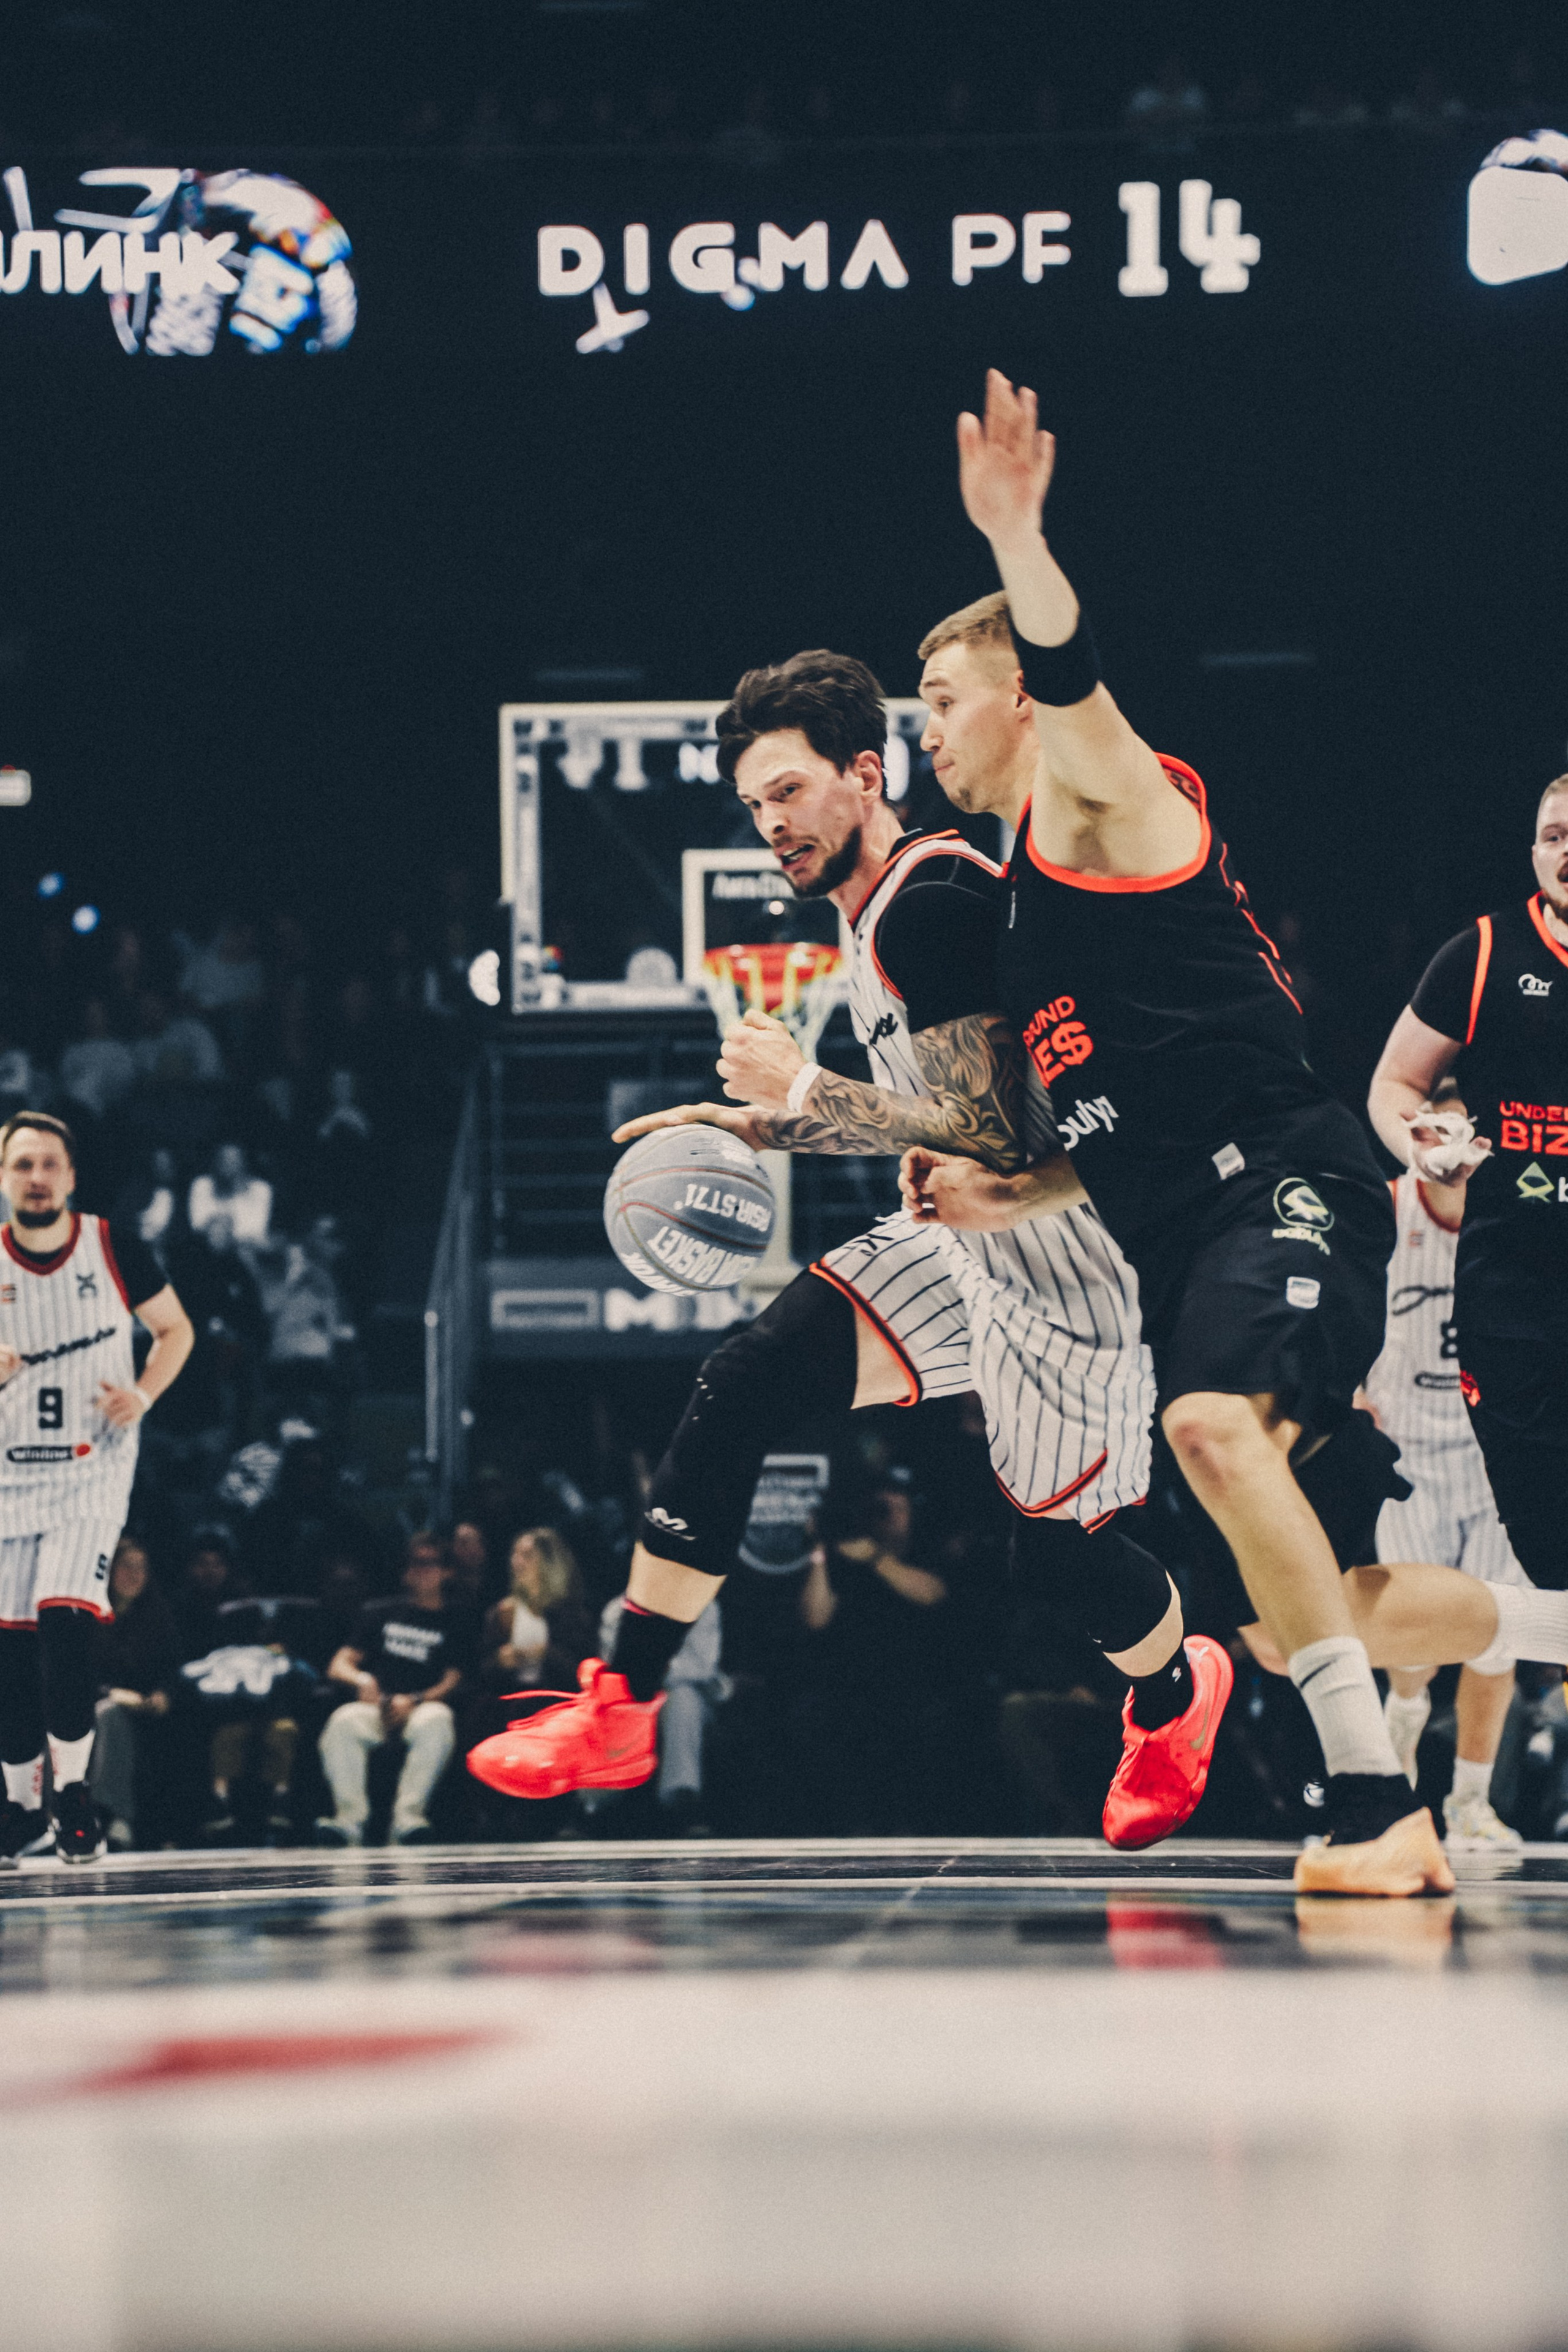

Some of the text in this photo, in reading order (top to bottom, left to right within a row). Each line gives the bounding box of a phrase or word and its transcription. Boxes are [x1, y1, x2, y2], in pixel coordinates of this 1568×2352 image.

[0, 230, 240, 294] ЛИНК
[537, 178, 1262, 298] DIGMA PF 14
[1499, 1100, 1568, 1122] UNDE
